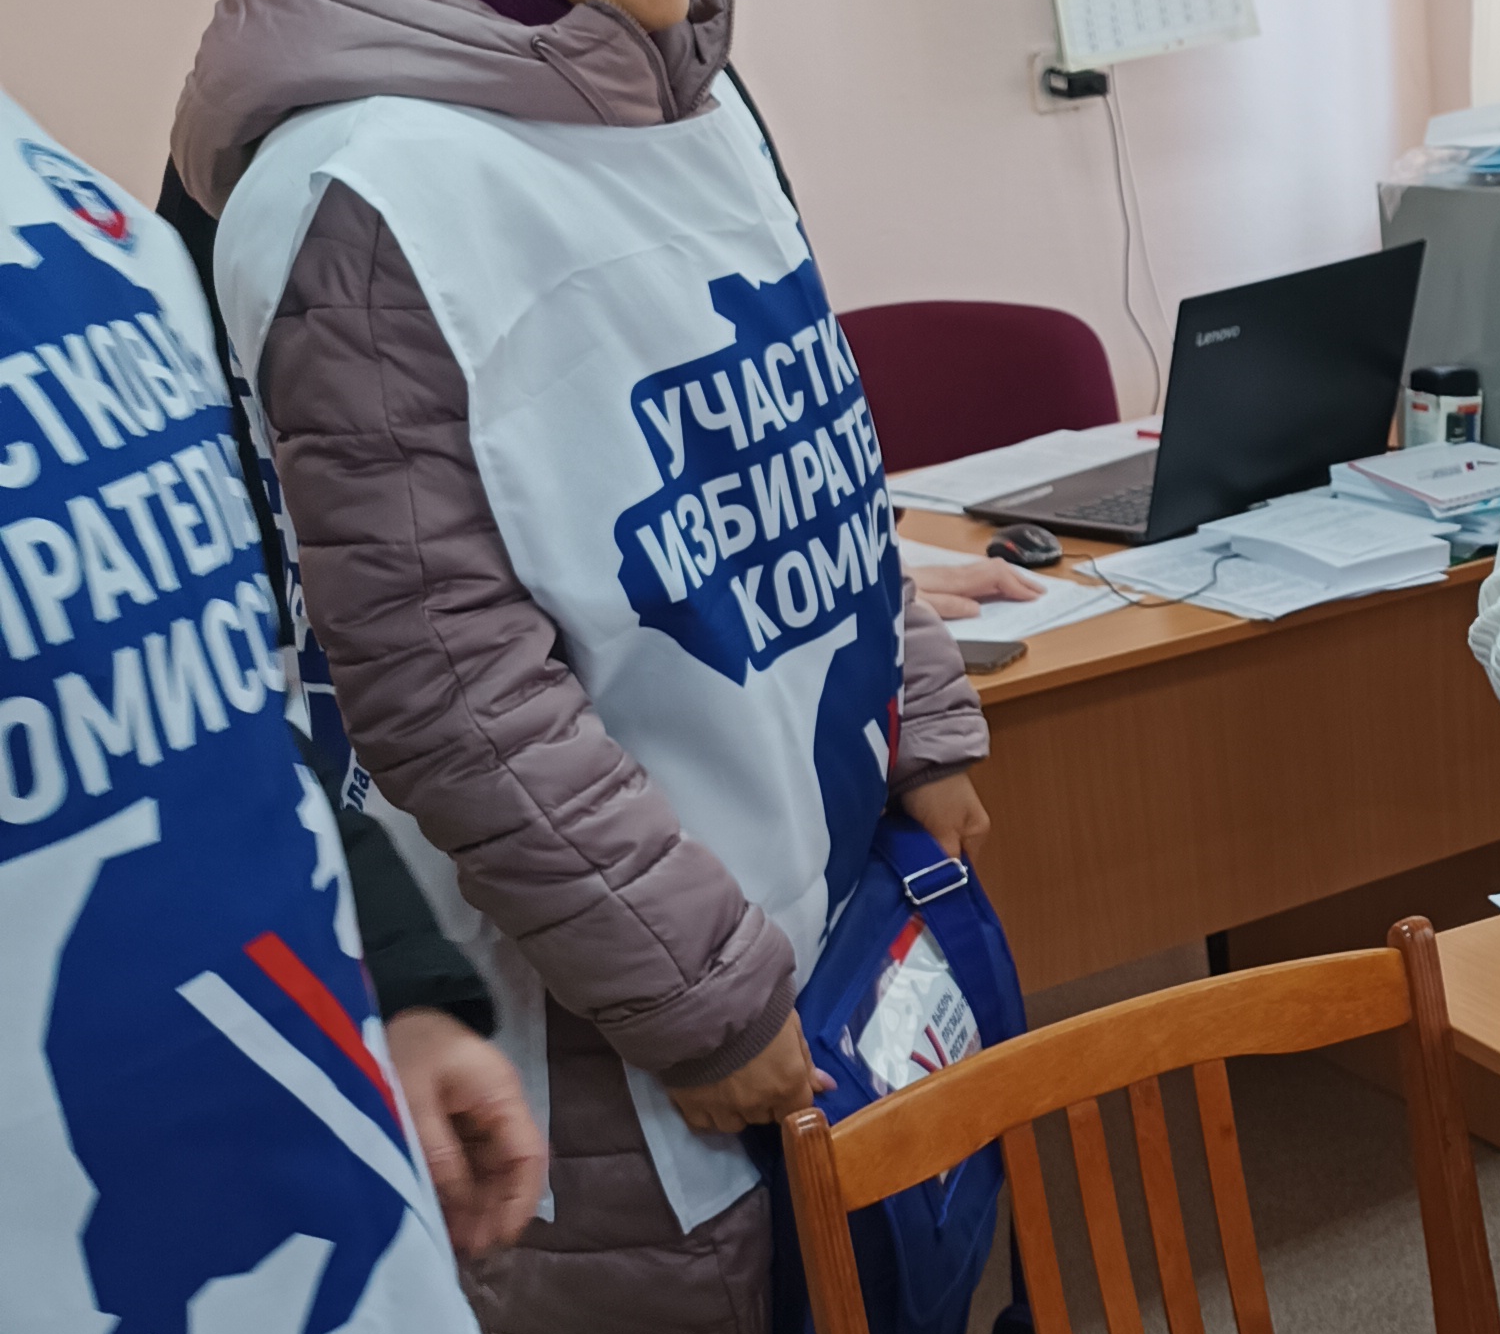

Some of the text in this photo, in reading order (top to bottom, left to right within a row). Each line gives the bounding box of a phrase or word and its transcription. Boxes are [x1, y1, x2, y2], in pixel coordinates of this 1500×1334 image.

[1196, 325, 1240, 347] Lenovo
[636, 396, 882, 603] ИЗБИРАТЕ
[0, 573, 284, 825] ОМИСС
